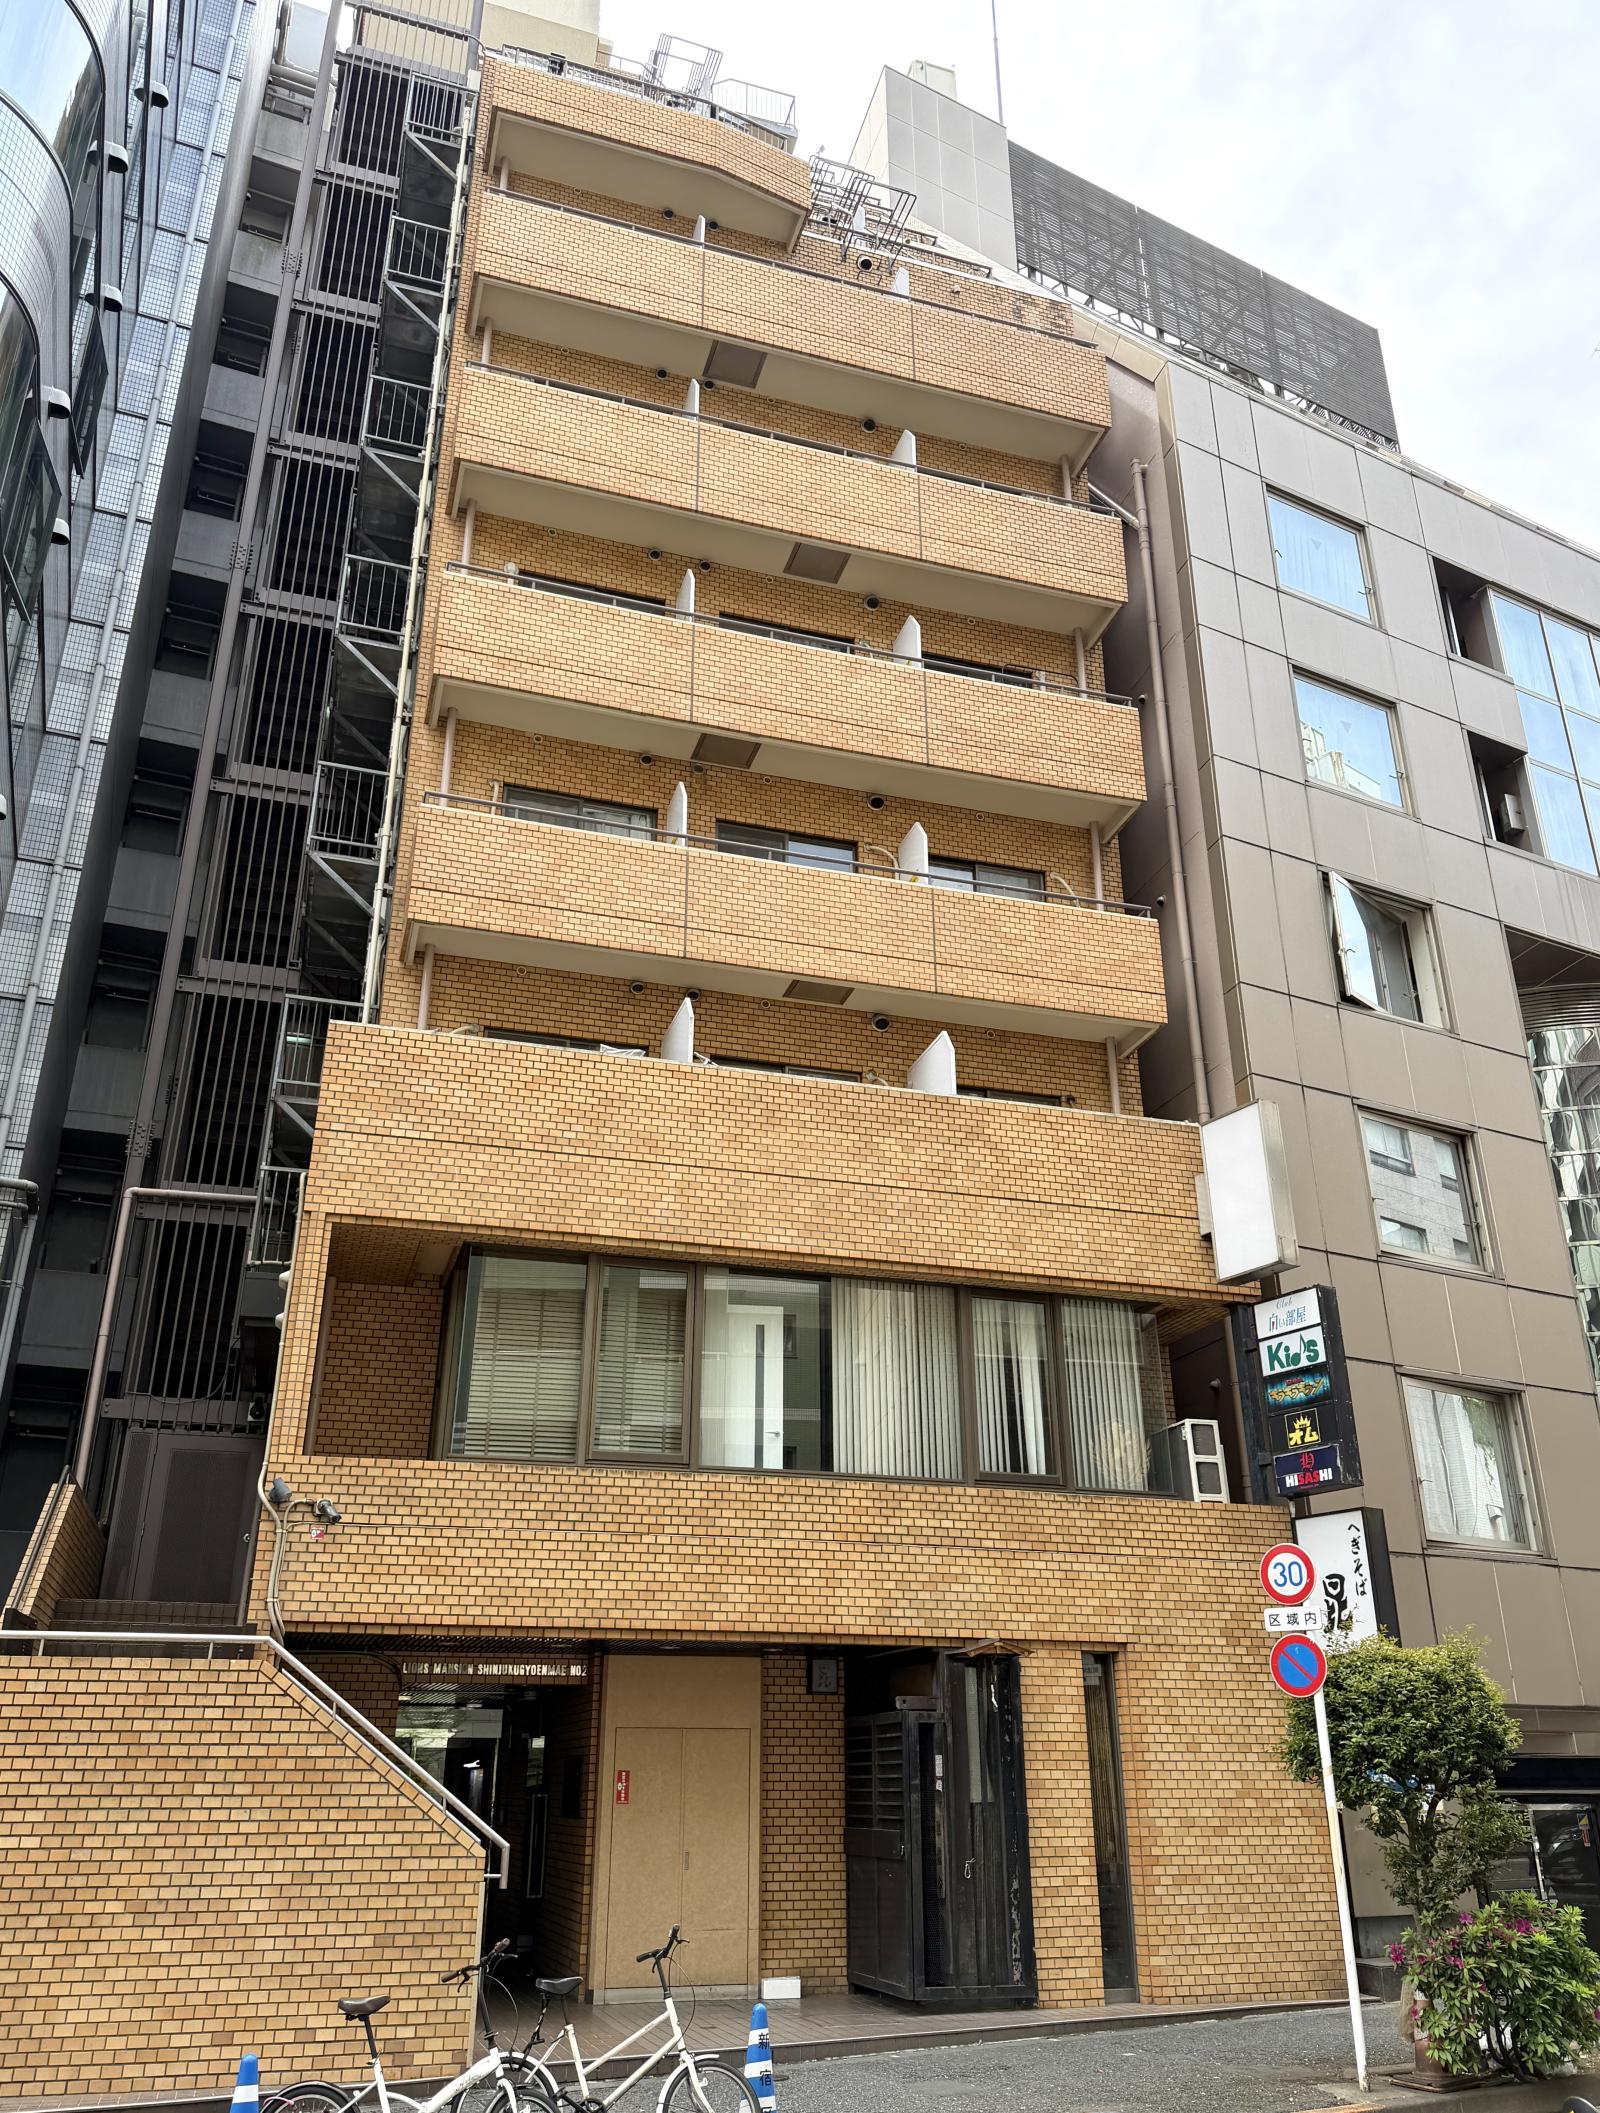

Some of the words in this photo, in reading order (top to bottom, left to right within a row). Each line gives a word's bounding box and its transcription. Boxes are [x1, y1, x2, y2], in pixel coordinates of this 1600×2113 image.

[1289, 1426, 1319, 1446] オム
[1285, 1467, 1333, 1488] HISASHI
[1347, 1523, 1368, 1597] へぎそば
[1273, 1561, 1303, 1588] 30
[1268, 1611, 1317, 1627] 区域内
[402, 1662, 429, 1674] LIONS
[433, 1663, 474, 1675] MANSION
